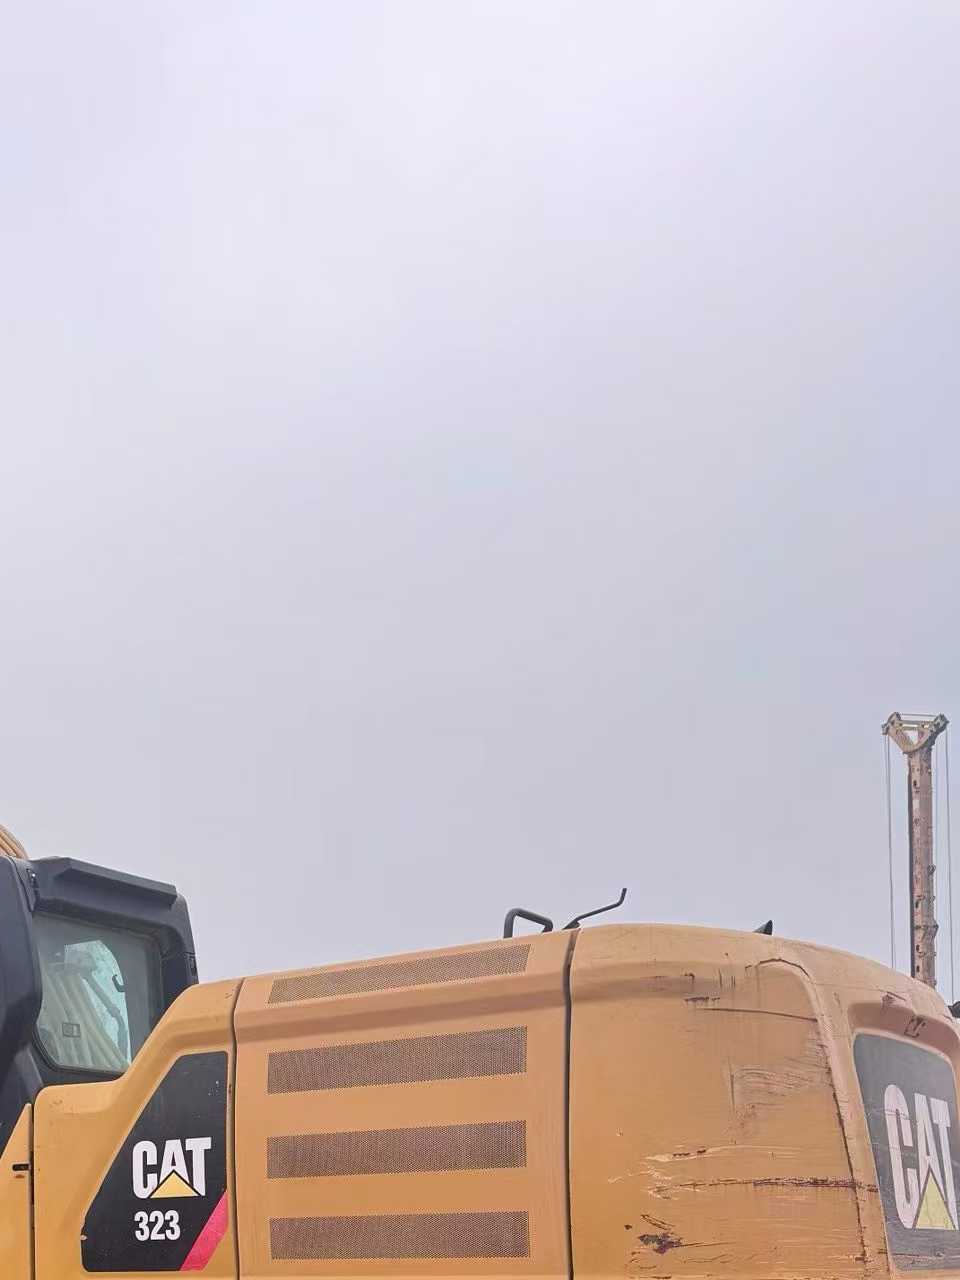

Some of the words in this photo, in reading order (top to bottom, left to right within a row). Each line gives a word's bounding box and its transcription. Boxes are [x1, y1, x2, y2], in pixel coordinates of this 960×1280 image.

[132, 1137, 212, 1199] CAT
[884, 1084, 959, 1230] CAT
[134, 1210, 181, 1241] 323
